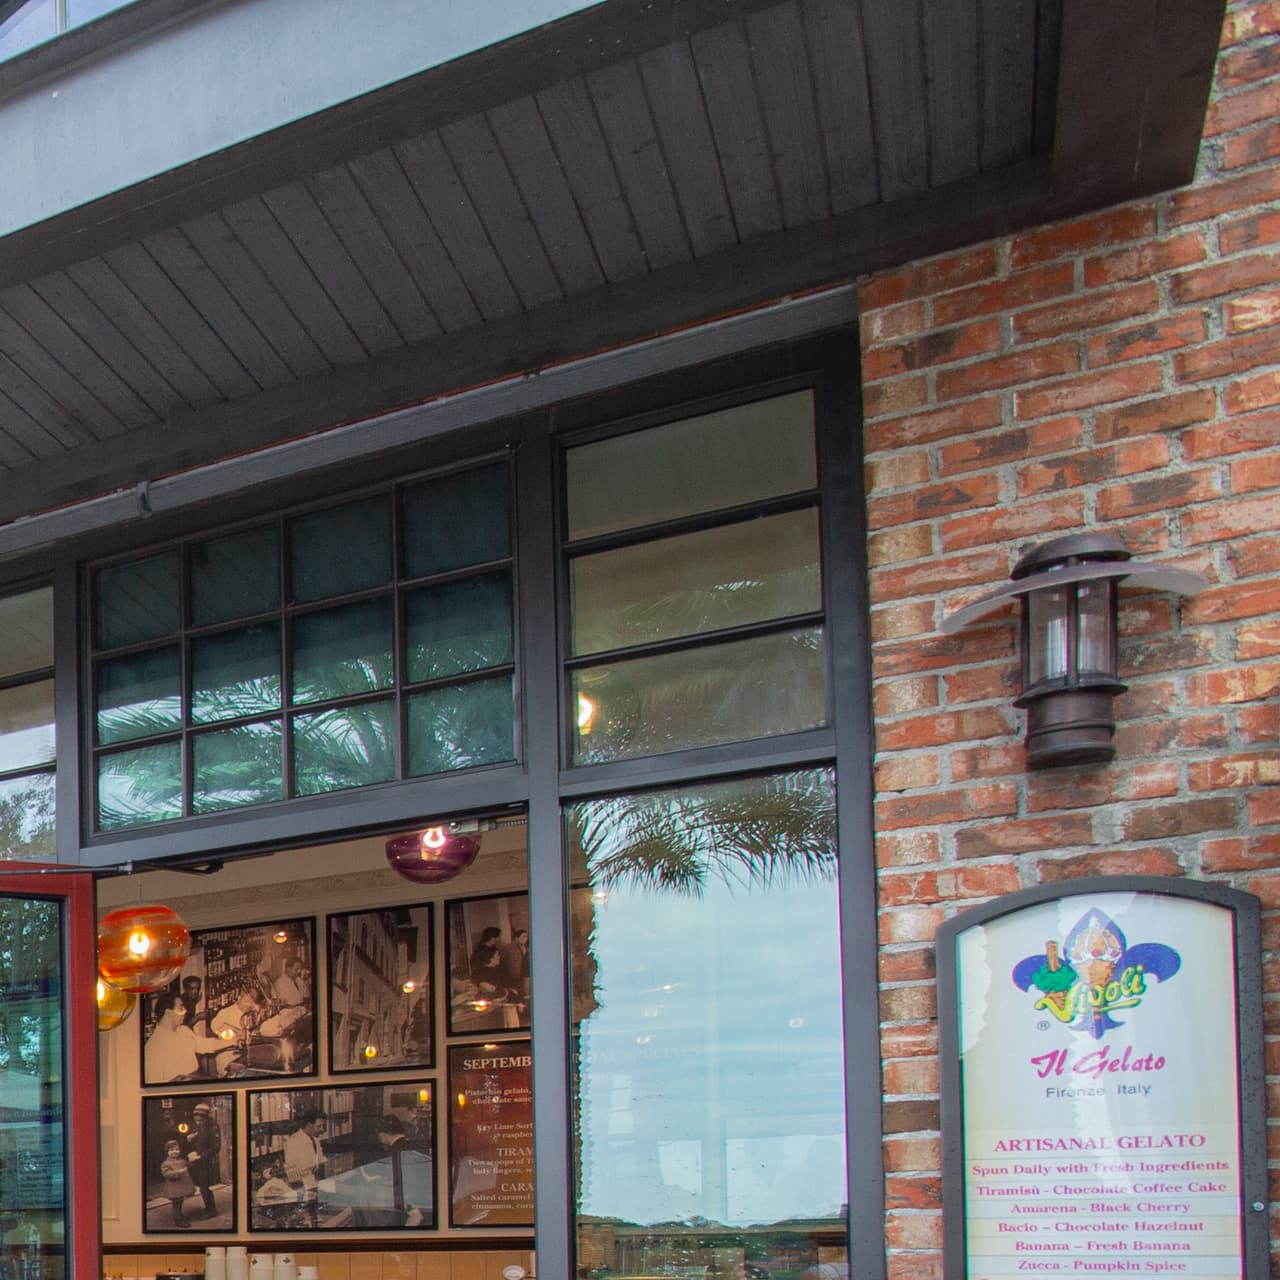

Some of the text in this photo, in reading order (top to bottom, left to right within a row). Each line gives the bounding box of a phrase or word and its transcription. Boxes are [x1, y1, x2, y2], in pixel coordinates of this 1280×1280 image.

[1034, 965, 1147, 1024] Vivoli
[463, 1056, 532, 1070] SEPTEMB
[1072, 1044, 1166, 1079] Gelato
[1046, 1086, 1105, 1098] Firenze
[994, 1134, 1205, 1152] ARTISANAL GELATO
[972, 1161, 1228, 1176] Spun Daily with Fresh Ingredients
[501, 1183, 534, 1193] CARA
[1052, 1184, 1127, 1195] Chocolate
[1131, 1184, 1182, 1194] Coffee
[1187, 1182, 1226, 1193] Cake
[471, 1193, 531, 1201] Salted caramel
[1010, 1203, 1078, 1213] Amarena
[1090, 1203, 1130, 1213] Black
[1136, 1202, 1190, 1214] Cherry
[997, 1222, 1038, 1233] Bacio
[1054, 1223, 1129, 1232] Chocolate
[1134, 1221, 1203, 1231] Hazelnut
[1014, 1241, 1070, 1251] Banana
[1087, 1241, 1127, 1251] Fresh
[1133, 1240, 1191, 1251] Banana
[1018, 1261, 1061, 1271] Zucca
[1072, 1261, 1140, 1272] Pumpkin
[1145, 1261, 1186, 1271] Spice
